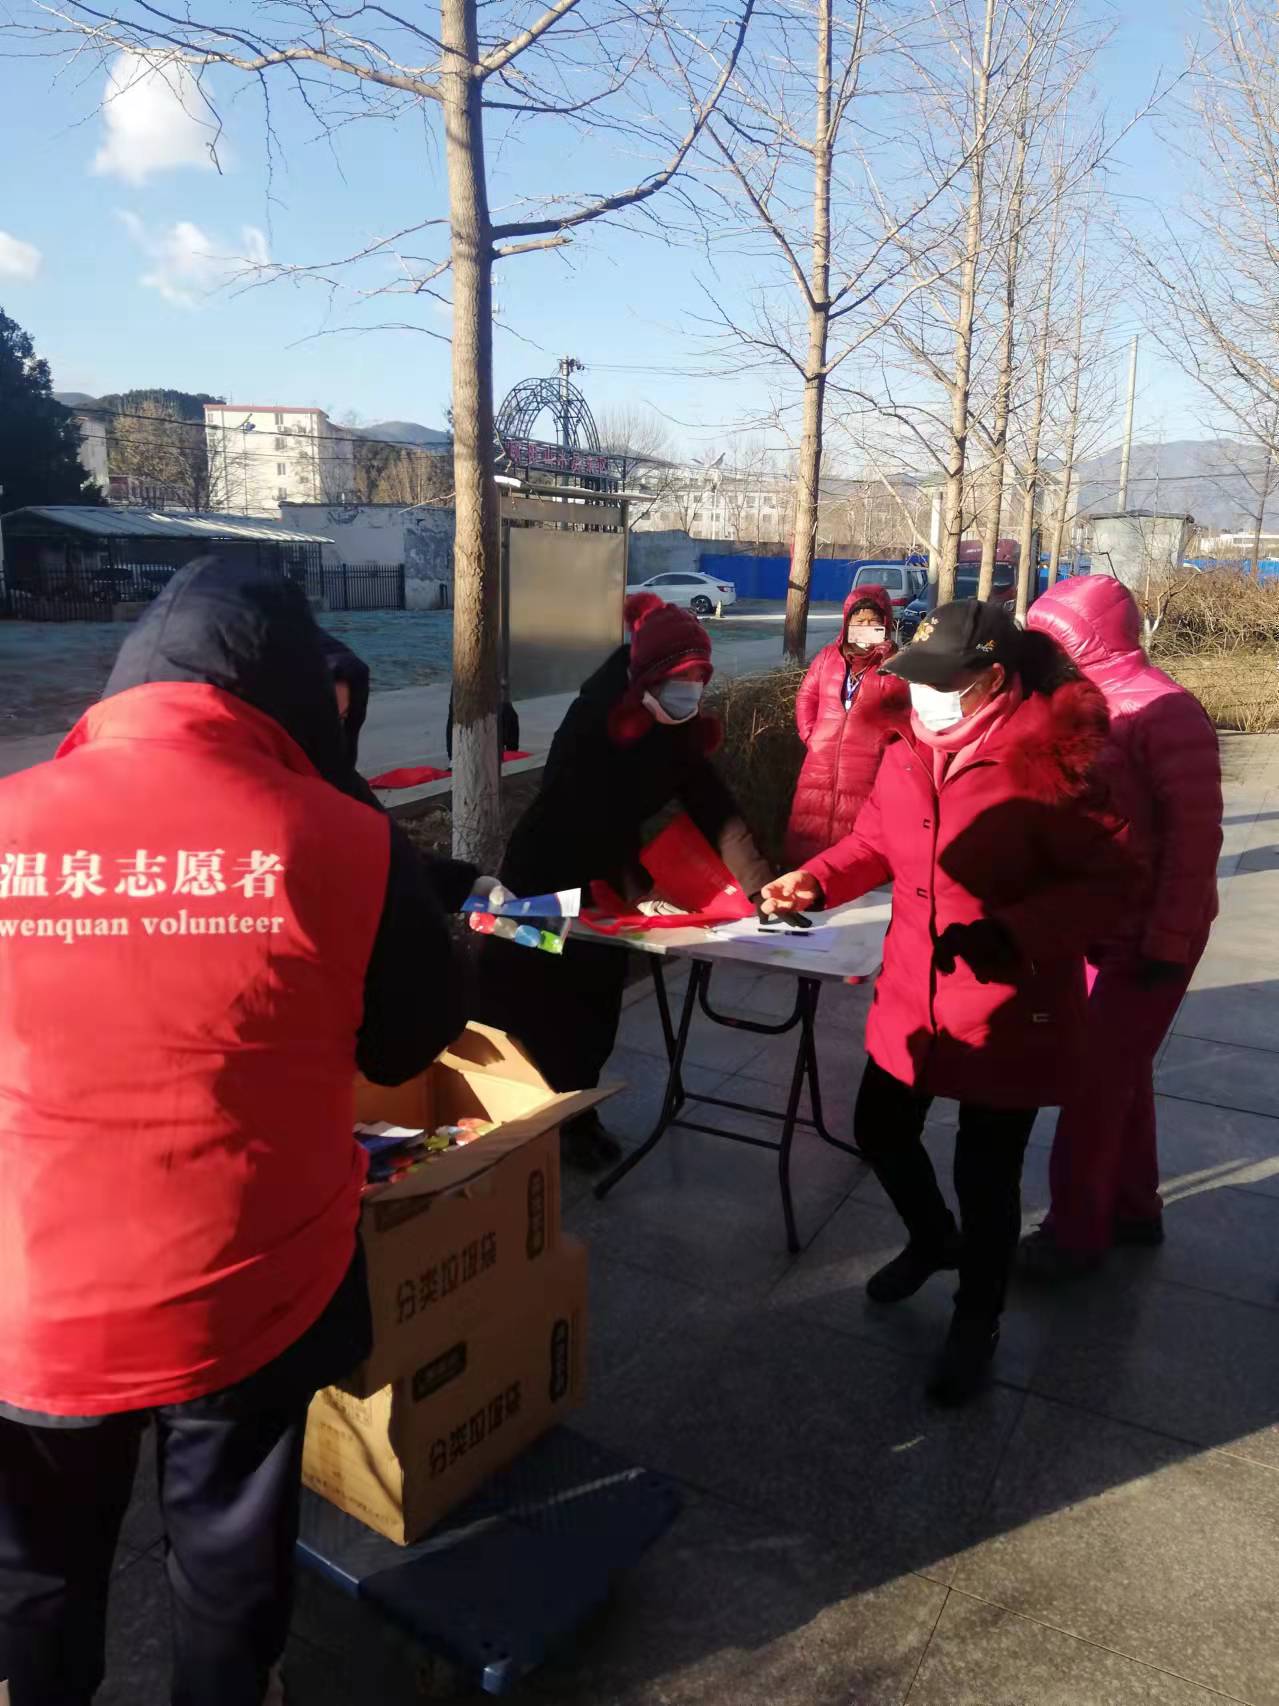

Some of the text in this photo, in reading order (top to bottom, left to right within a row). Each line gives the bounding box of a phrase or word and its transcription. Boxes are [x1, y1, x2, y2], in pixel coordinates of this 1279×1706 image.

[0, 849, 285, 898] 温泉志愿者
[0, 908, 285, 944] wenquan volunteer
